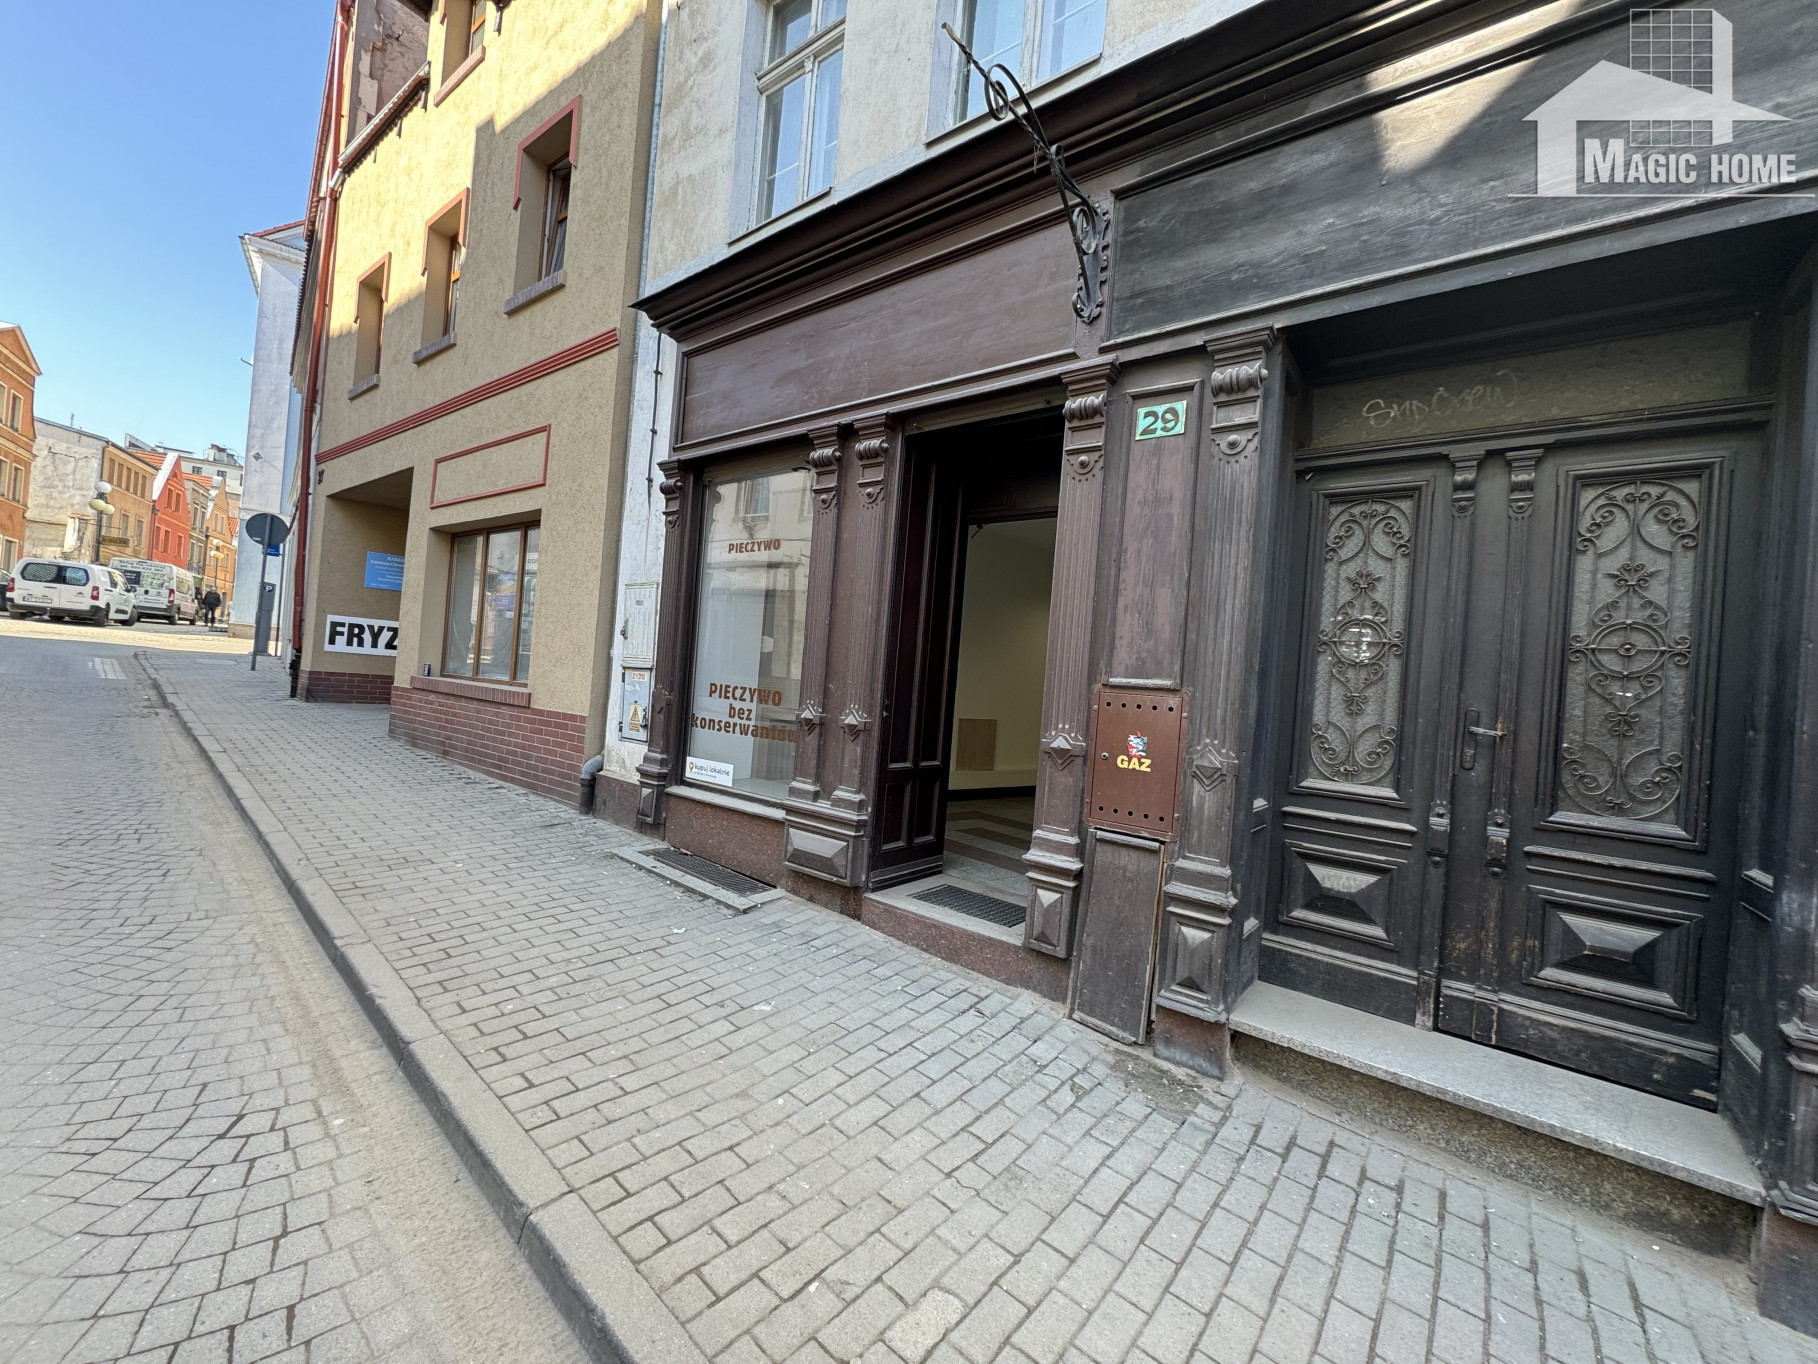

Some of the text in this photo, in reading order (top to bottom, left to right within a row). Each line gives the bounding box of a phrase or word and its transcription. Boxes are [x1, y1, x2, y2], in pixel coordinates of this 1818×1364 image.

[1139, 406, 1180, 437] 29
[728, 539, 781, 554] PIECZYWO
[327, 621, 398, 651] FRYZ
[709, 682, 782, 707] PIECZYWO
[728, 703, 753, 721] bez
[709, 765, 730, 777] lokalnie
[1116, 755, 1152, 772] GAZ
